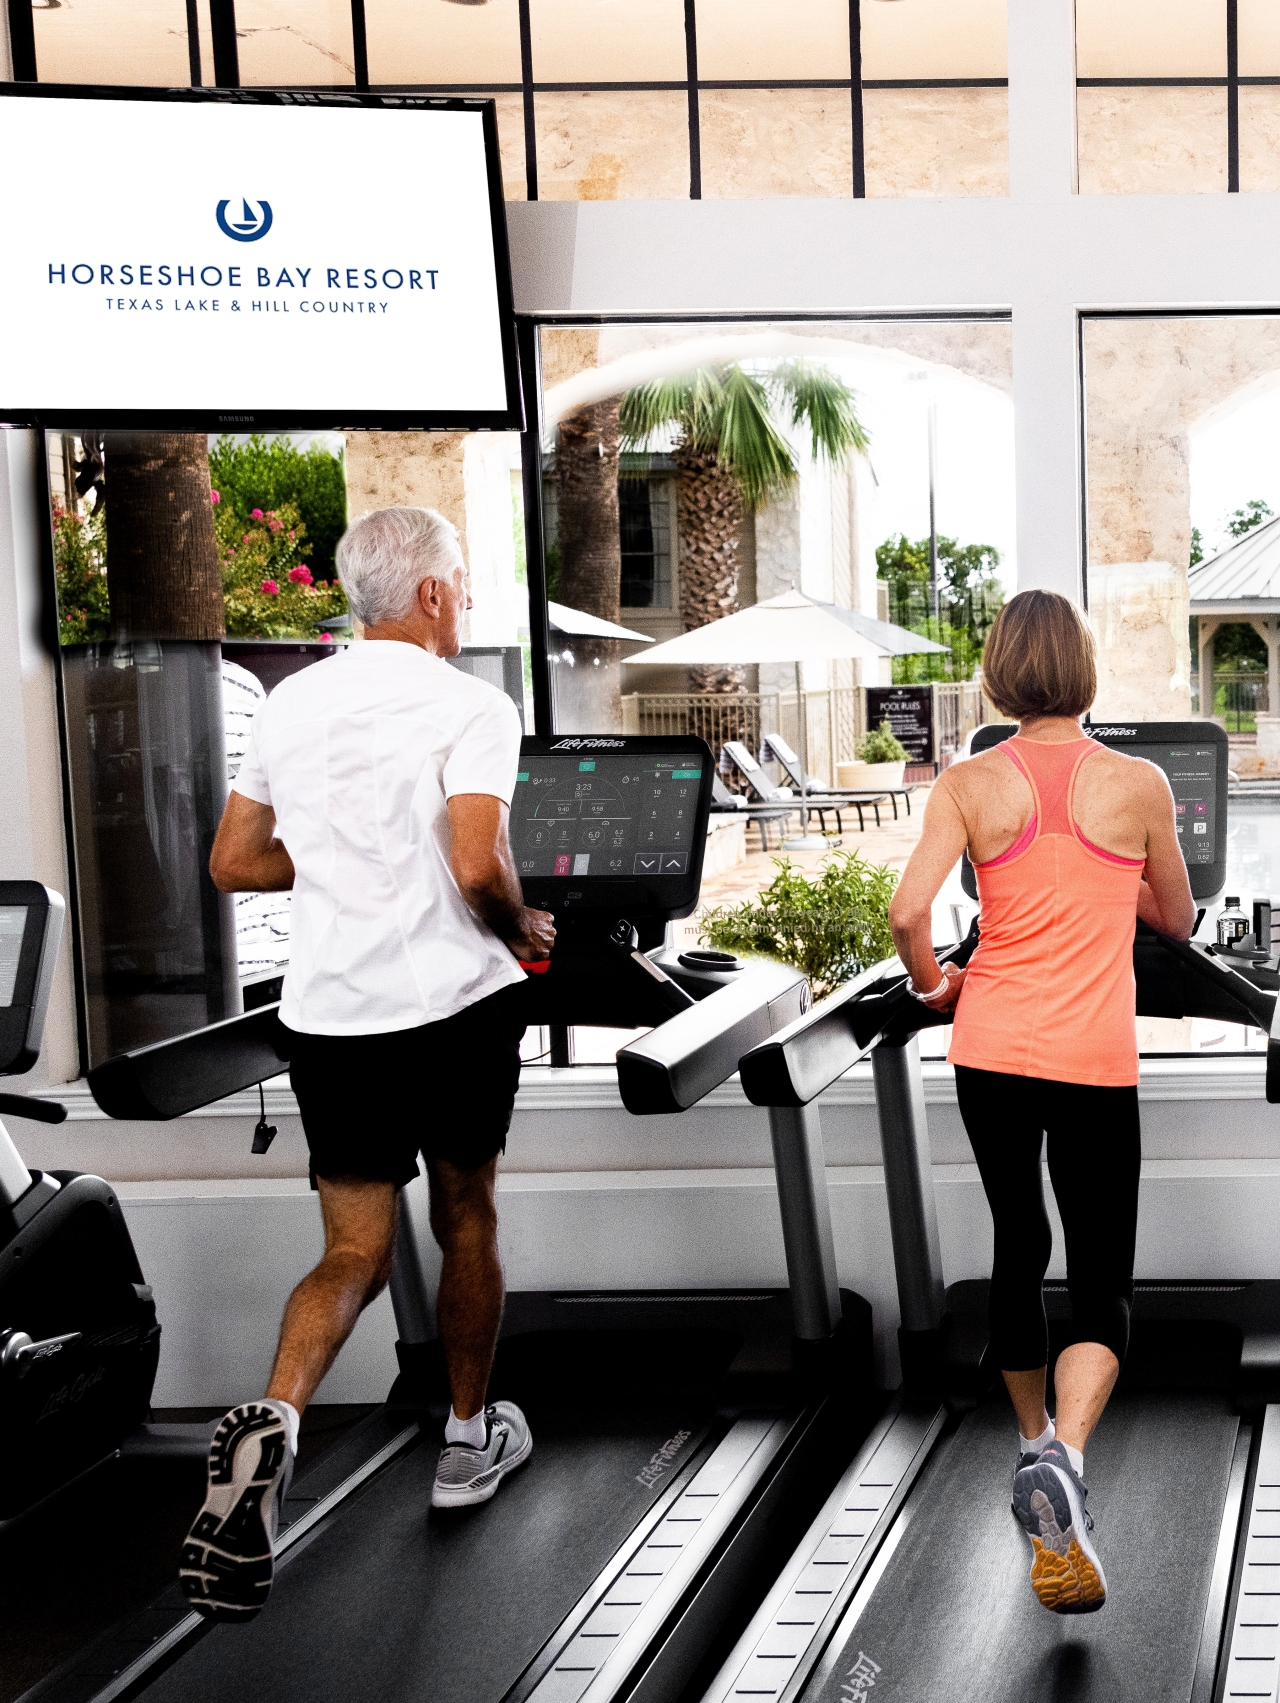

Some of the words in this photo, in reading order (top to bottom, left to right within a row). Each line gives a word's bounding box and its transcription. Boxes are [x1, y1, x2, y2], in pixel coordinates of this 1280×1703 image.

[48, 263, 242, 287] HORSESHOE
[257, 266, 312, 288] BAY
[327, 269, 439, 290] RESORT
[106, 297, 165, 311] TEXAS
[175, 298, 220, 312] LAKE
[230, 300, 241, 312] &
[252, 300, 290, 313] HILL
[300, 300, 389, 314] COUNTRY
[879, 701, 900, 712] POOL
[679, 788, 687, 796] 12
[609, 859, 622, 868] 6.2
